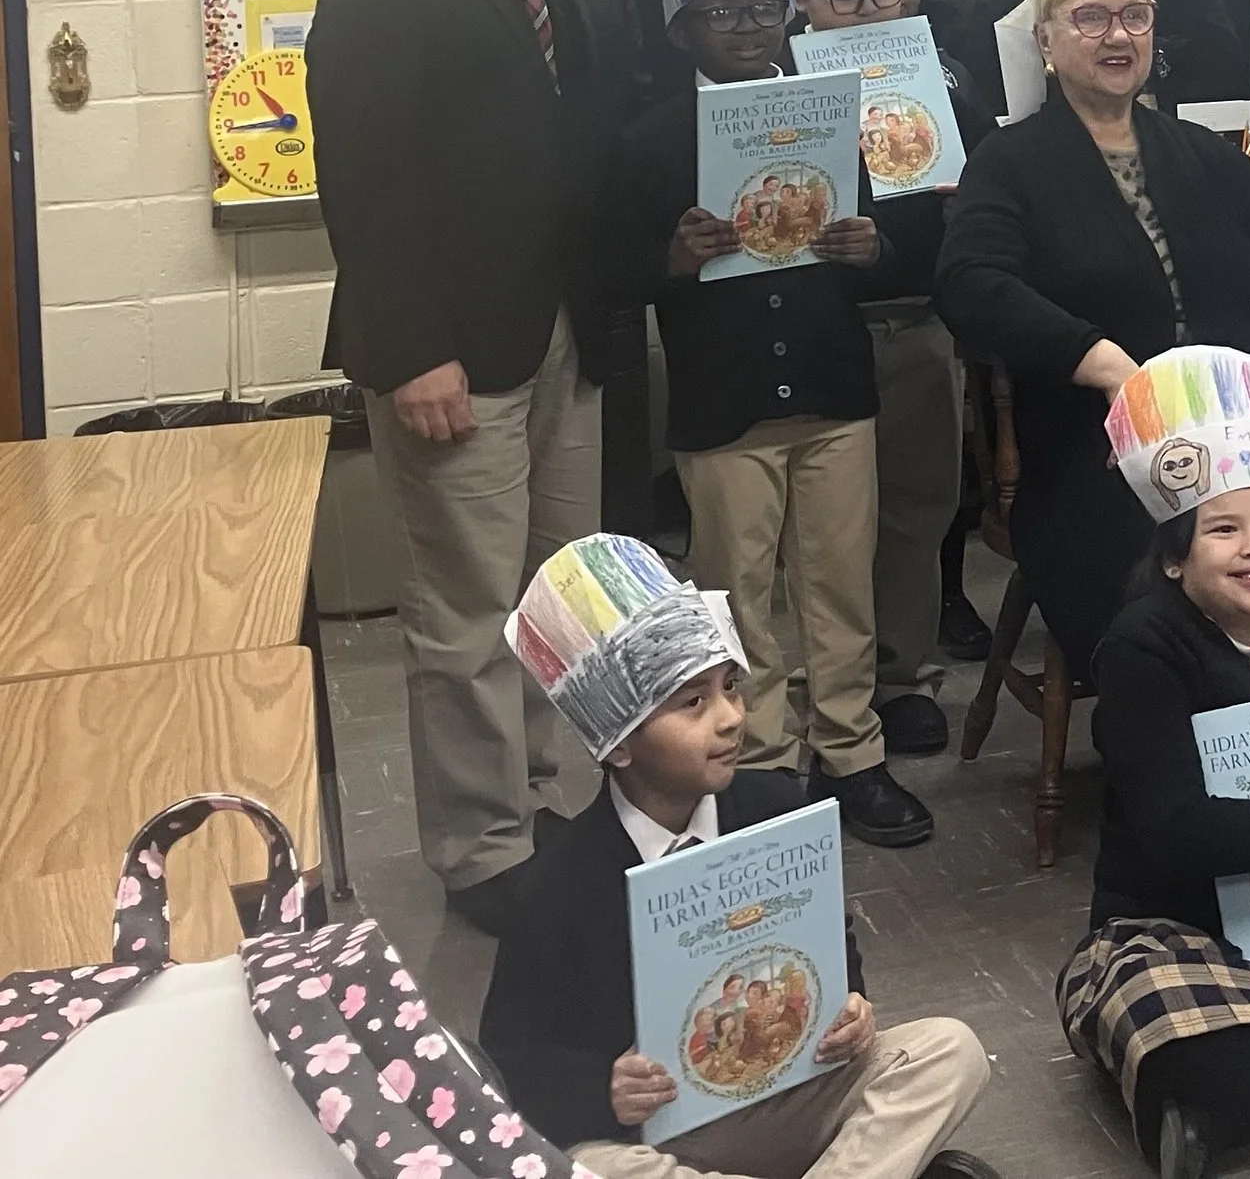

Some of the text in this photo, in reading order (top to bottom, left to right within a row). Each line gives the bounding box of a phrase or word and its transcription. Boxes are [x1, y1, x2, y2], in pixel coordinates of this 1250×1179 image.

[805, 45, 847, 62] LIDIA'S
[850, 32, 928, 54] EGG-CITING
[276, 61, 295, 77] 12
[811, 44, 930, 73] FARM ADVENTURE
[251, 70, 266, 86] 11
[231, 91, 250, 107] 10
[711, 103, 760, 123] LIDIA'S
[764, 92, 855, 116] EGG-CITING
[714, 106, 851, 137] FARM ADVENTURE
[234, 146, 246, 161] 8
[258, 162, 271, 178] 7
[286, 169, 298, 184] 6
[648, 879, 712, 916] LIDIA'S
[719, 834, 834, 891] EGG-CITING
[653, 900, 708, 934] FARM
[716, 855, 829, 911] ADVENTURE
